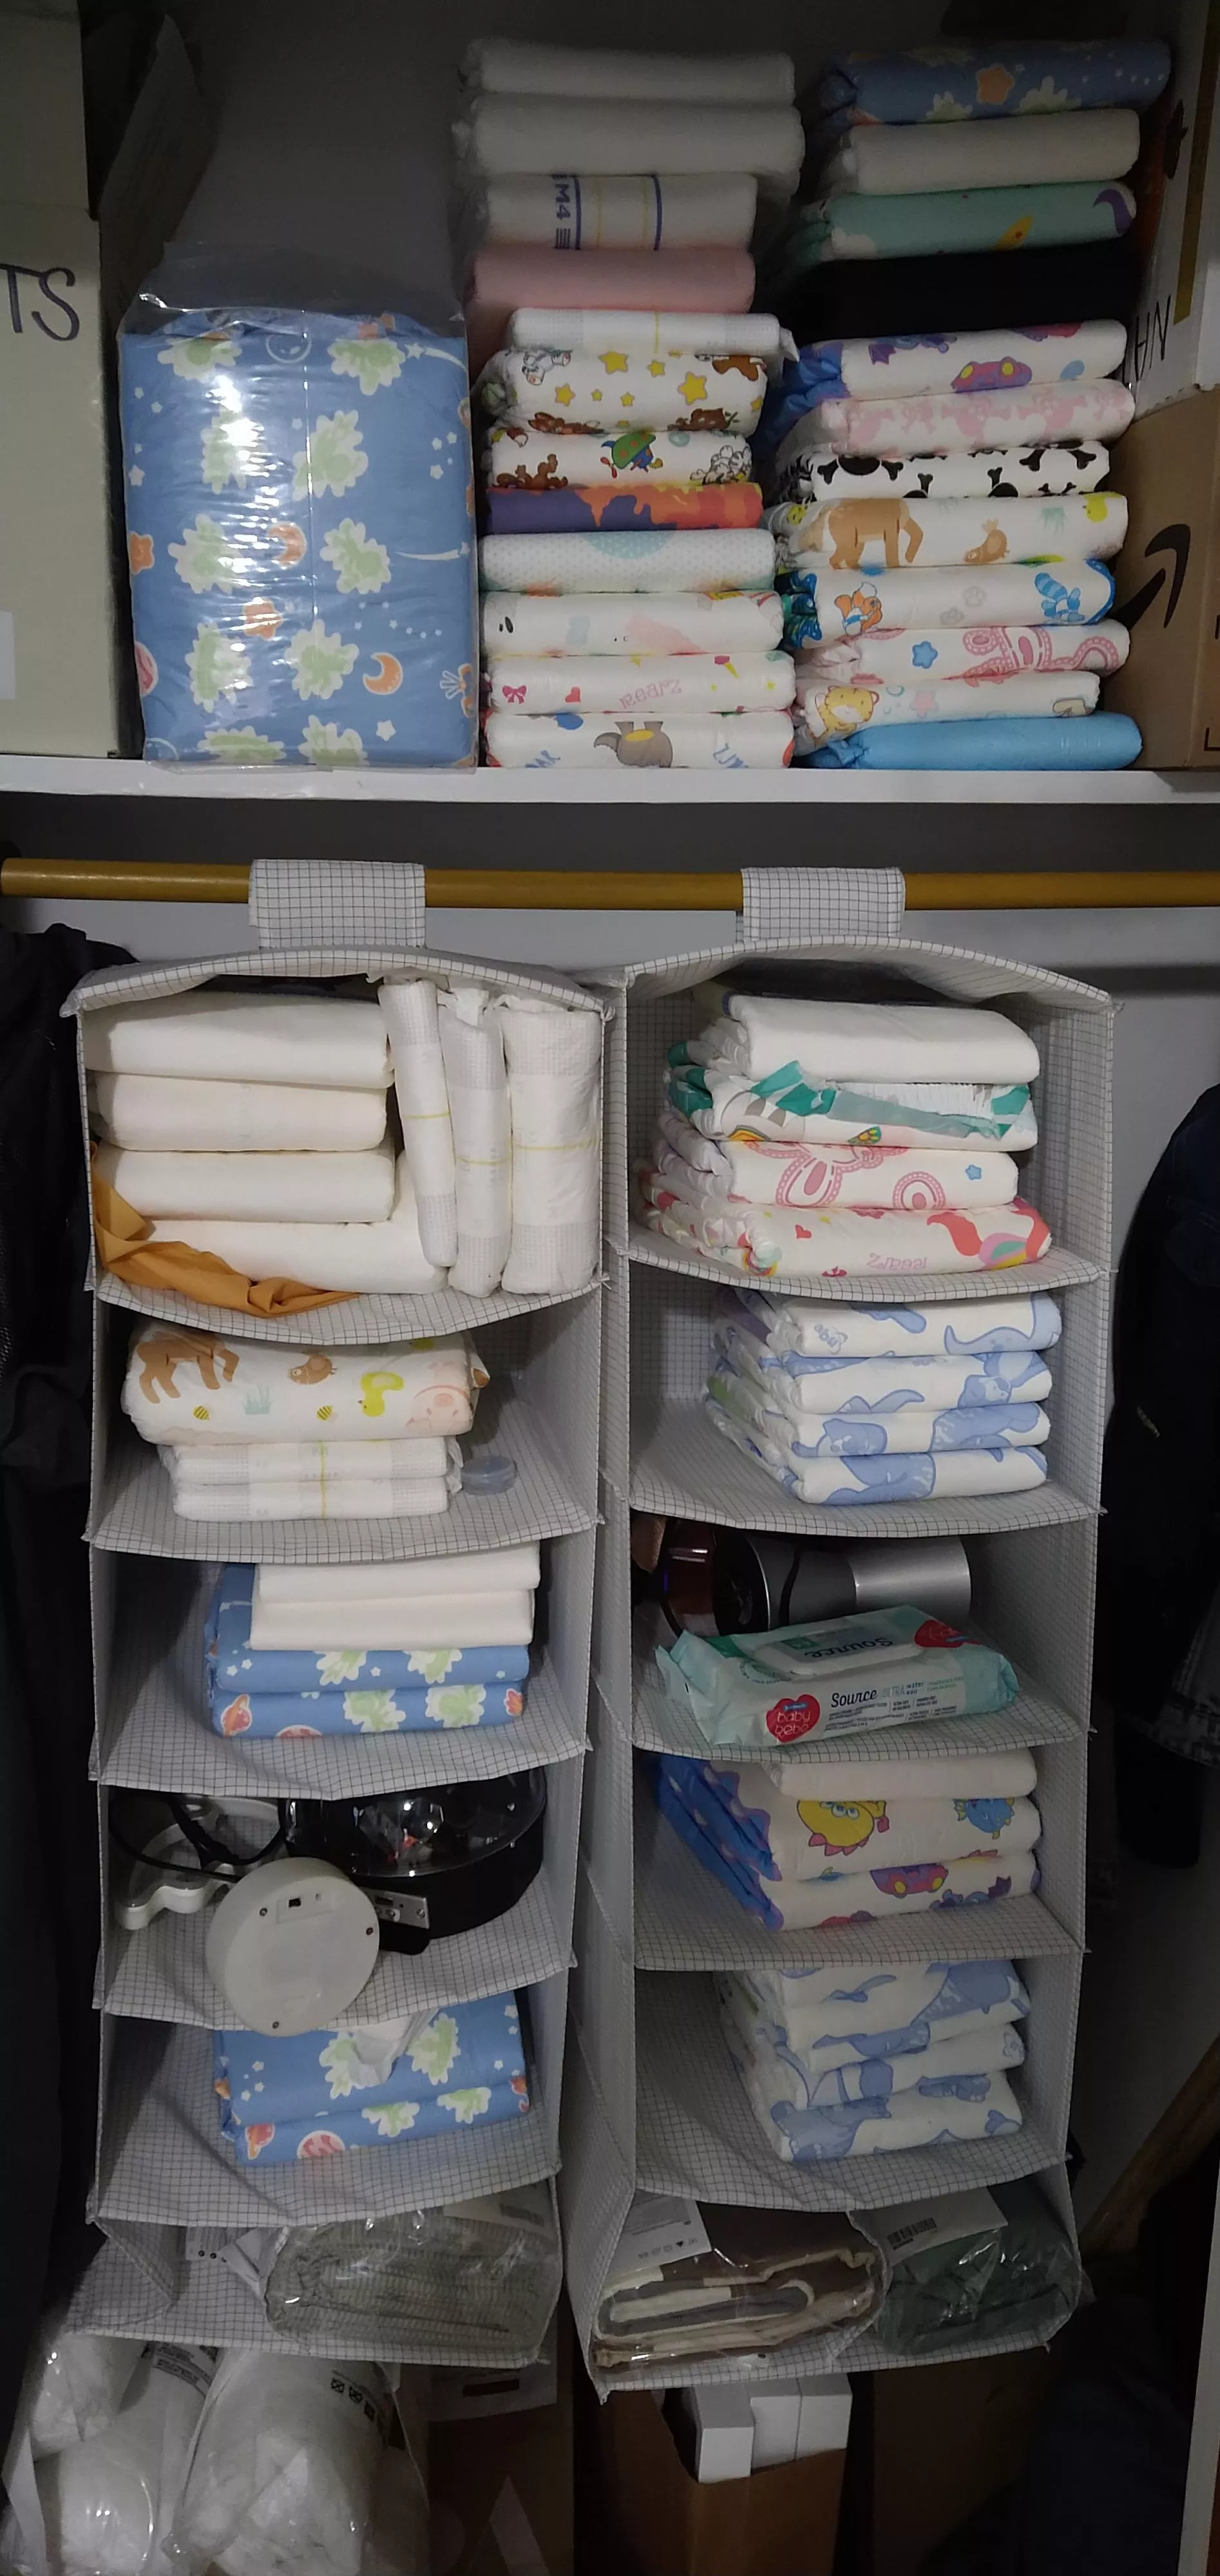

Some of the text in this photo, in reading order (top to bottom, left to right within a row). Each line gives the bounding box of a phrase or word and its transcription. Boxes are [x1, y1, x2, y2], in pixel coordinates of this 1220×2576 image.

[0, 263, 80, 341] TS
[804, 1637, 893, 1660] Source
[831, 1689, 877, 1708] Source
[777, 1710, 812, 1723] baby
